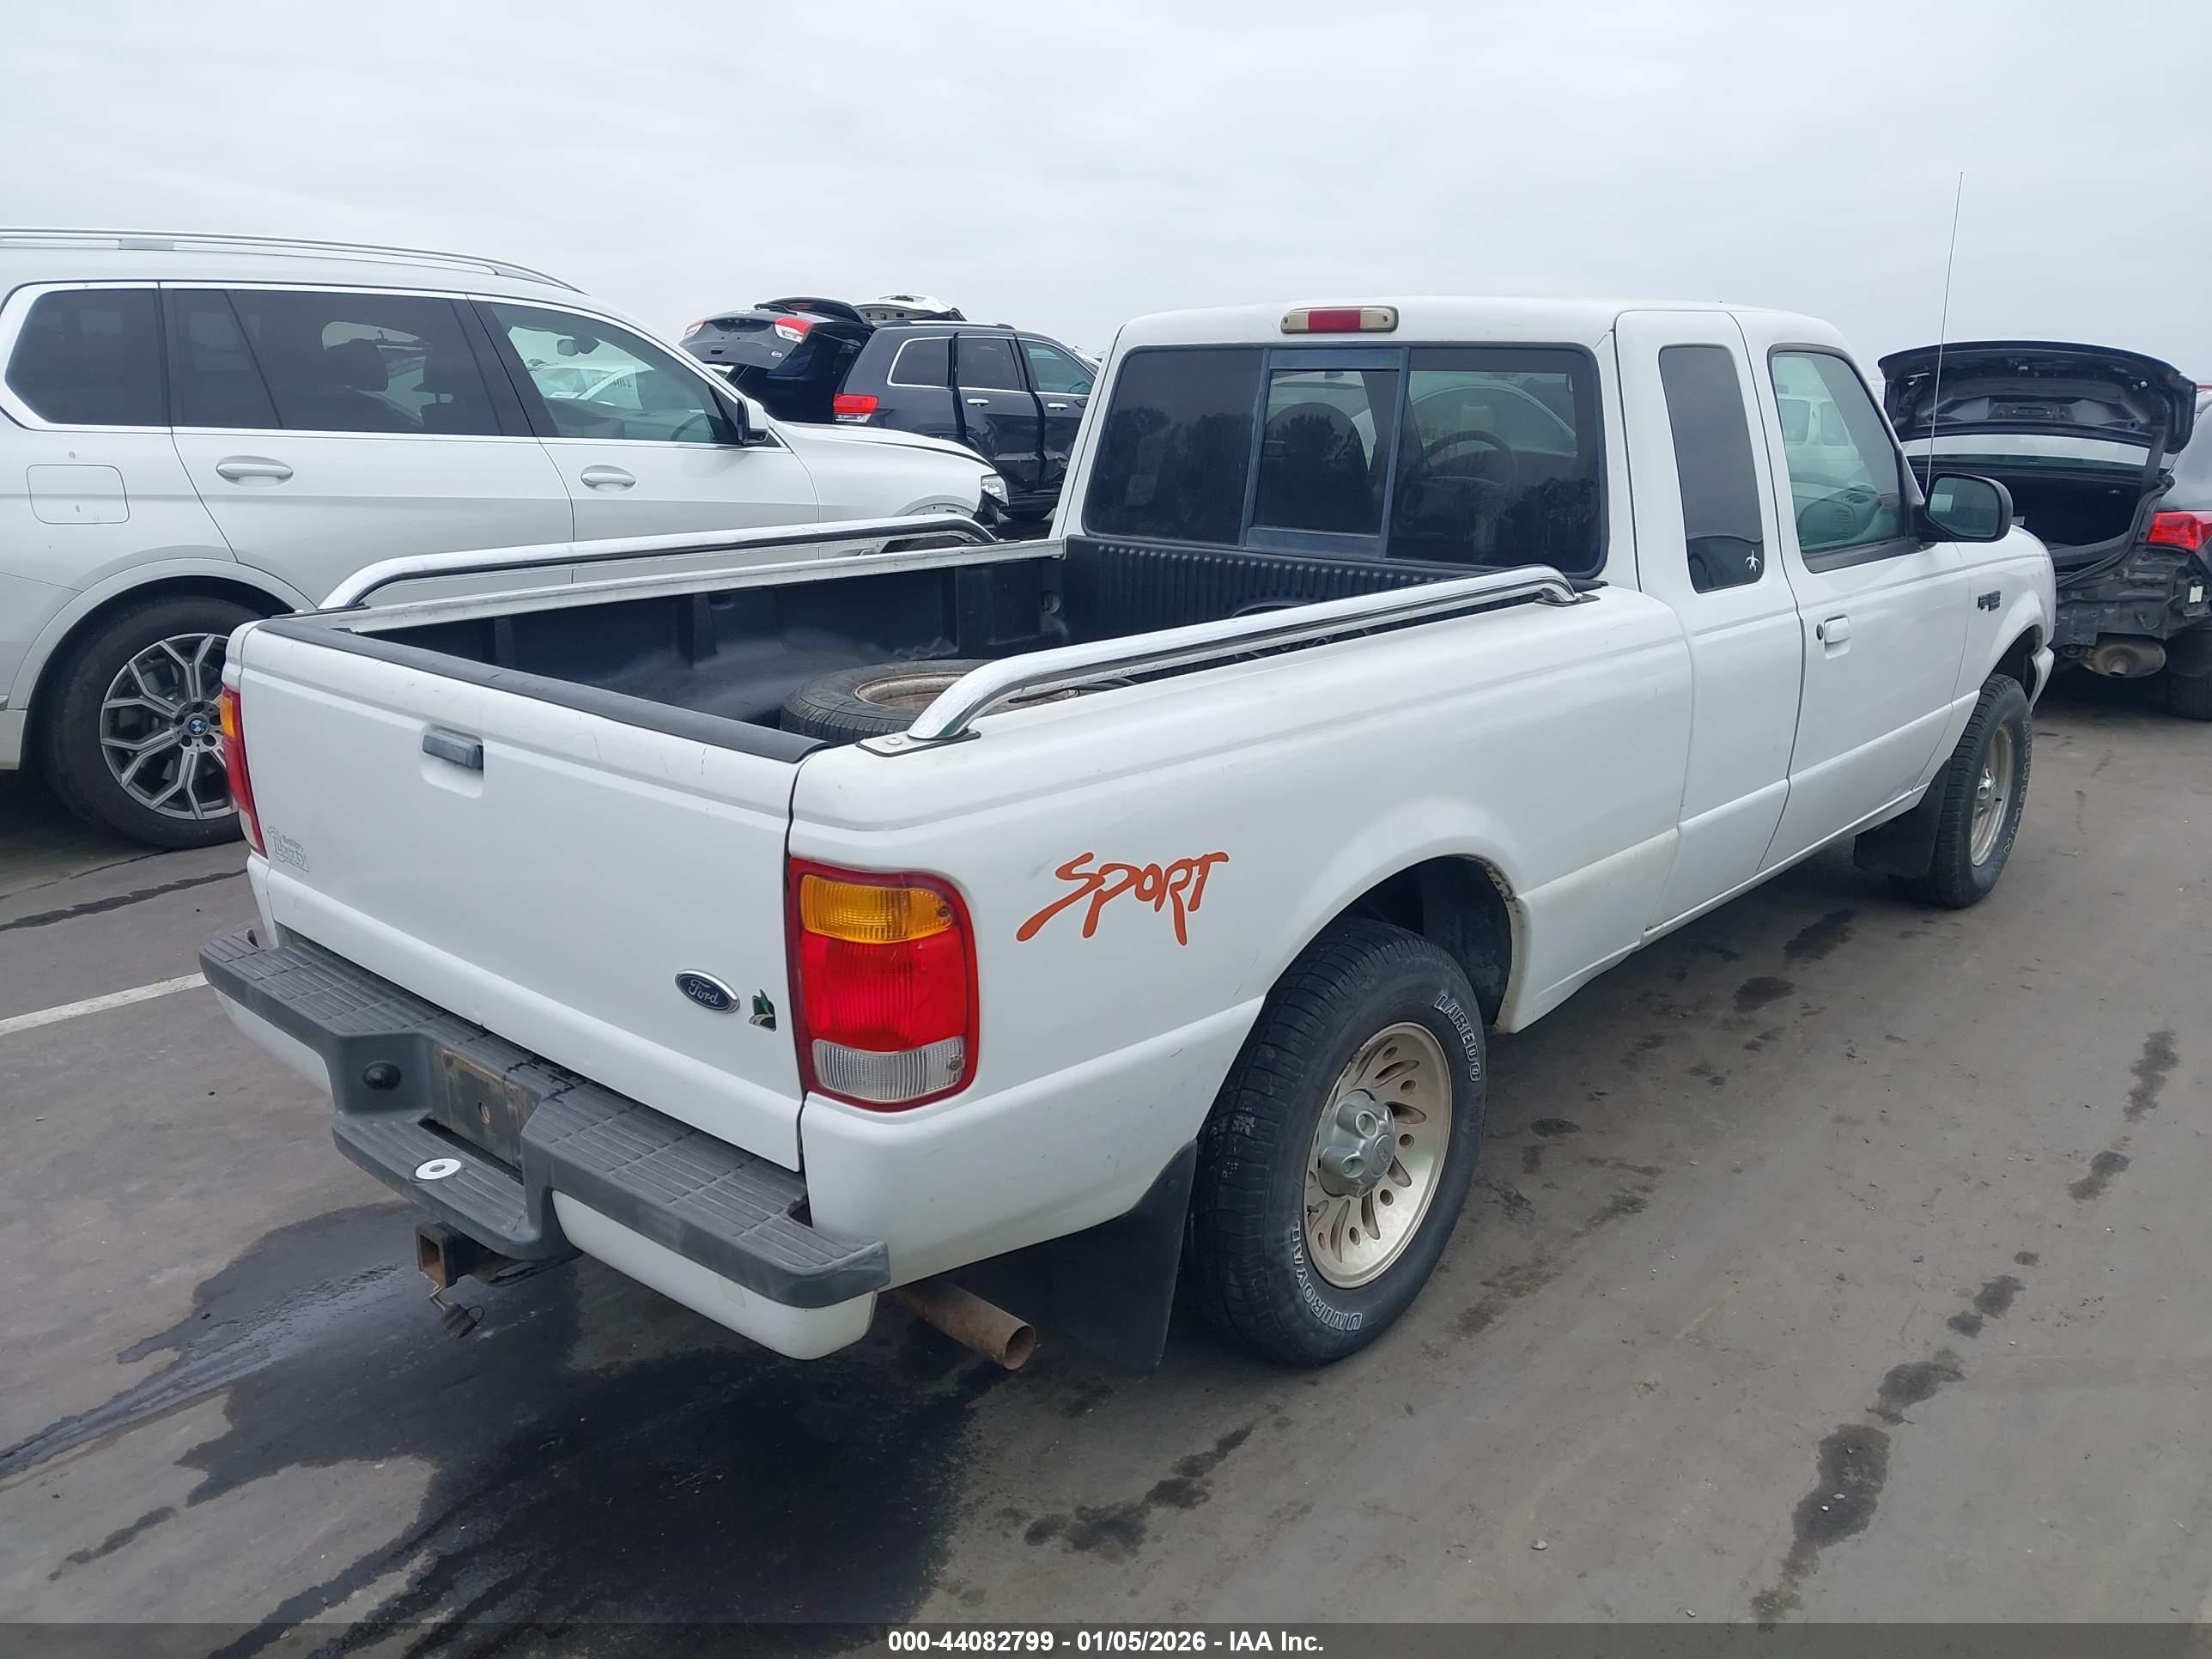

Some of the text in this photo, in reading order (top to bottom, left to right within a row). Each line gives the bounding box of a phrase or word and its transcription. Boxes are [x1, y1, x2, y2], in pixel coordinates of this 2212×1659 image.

[1016, 851, 1230, 946] SPORT
[688, 979, 720, 1005] Ford
[1433, 994, 1481, 1082] LAREDO
[1291, 1220, 1363, 1331] UNIROYAL
